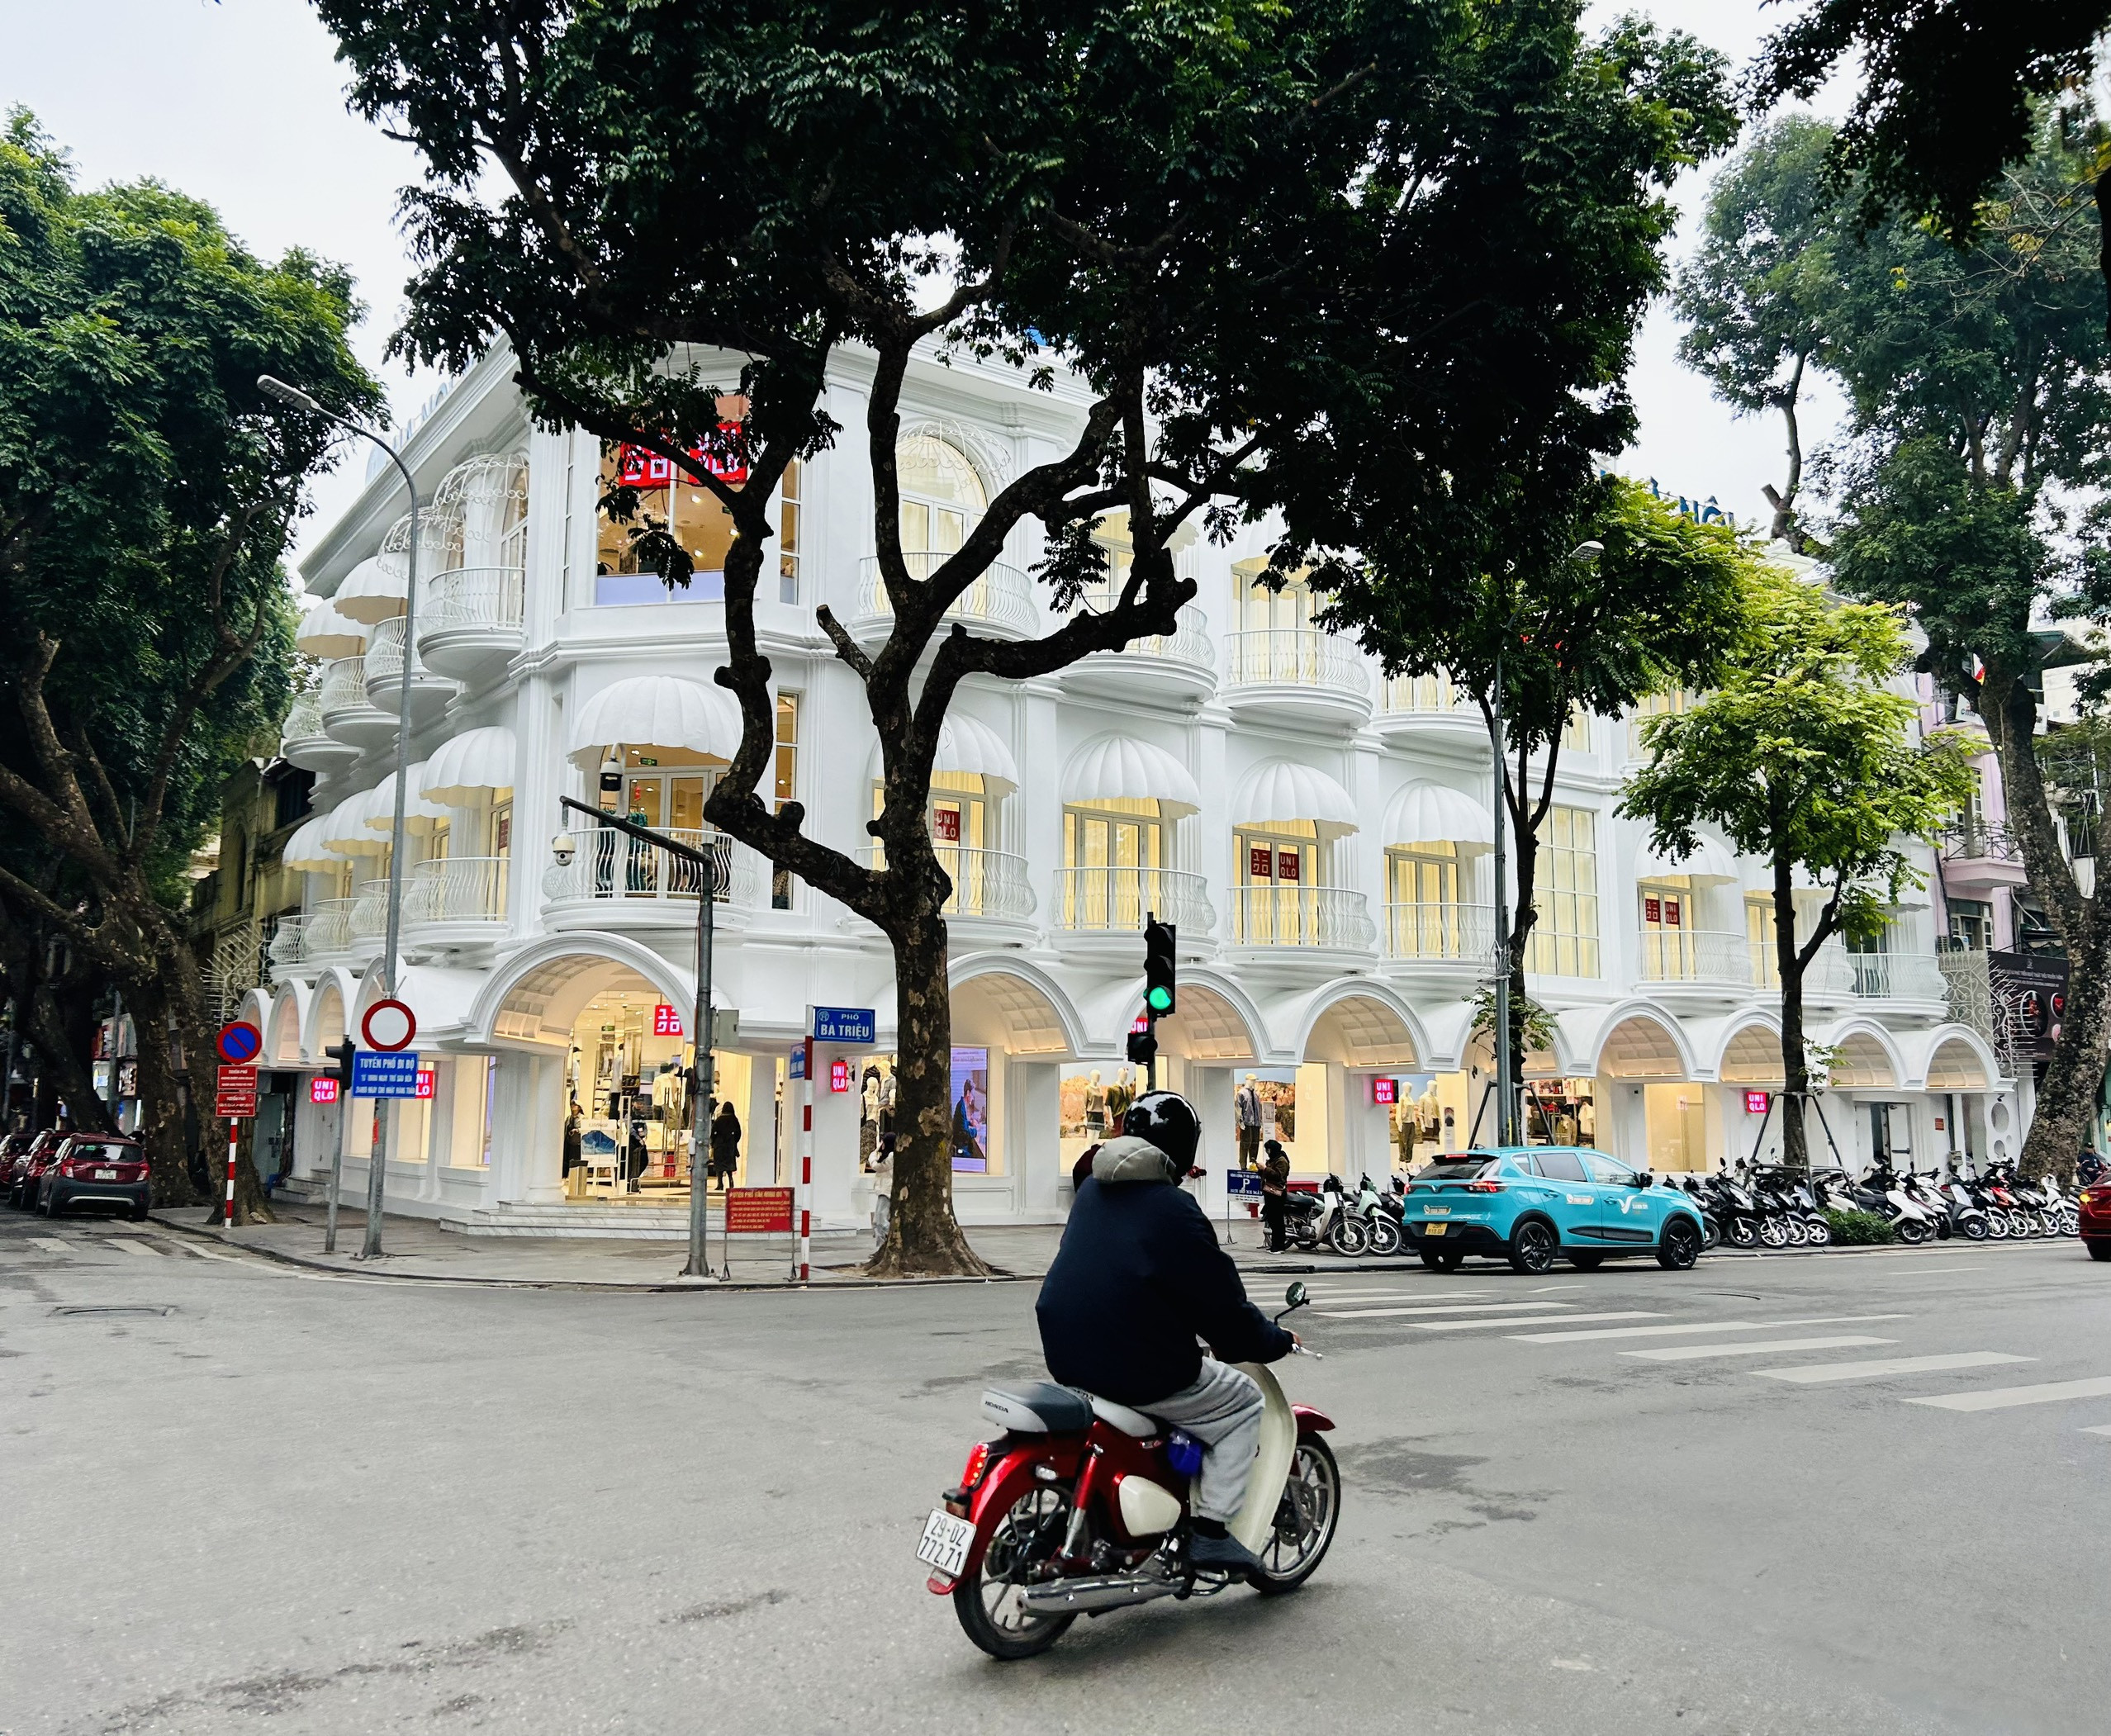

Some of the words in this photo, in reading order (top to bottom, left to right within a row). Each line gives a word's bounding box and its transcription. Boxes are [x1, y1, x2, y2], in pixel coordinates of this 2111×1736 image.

[936, 812, 955, 825] UNI
[936, 825, 956, 838] QLO
[1280, 855, 1295, 866] UNI
[1280, 866, 1297, 878] QLO
[1666, 904, 1677, 913] UNI
[1666, 913, 1678, 923] QLO
[838, 1022, 870, 1041] TRIỆU
[359, 1055, 382, 1069] TUYẾN
[382, 1056, 396, 1069] PHỐ
[833, 1065, 845, 1076] UNI
[415, 1073, 429, 1084] NI
[833, 1077, 846, 1090] QLO
[314, 1080, 334, 1090] UNI
[415, 1084, 430, 1096] LO
[1376, 1081, 1391, 1091] UNI
[314, 1090, 334, 1102] QLO
[1376, 1091, 1392, 1103] QLO
[1748, 1093, 1764, 1103] UNI
[1748, 1103, 1766, 1112] QLO
[984, 1400, 1009, 1413] HONDA
[918, 1535, 963, 1572] 772.71
